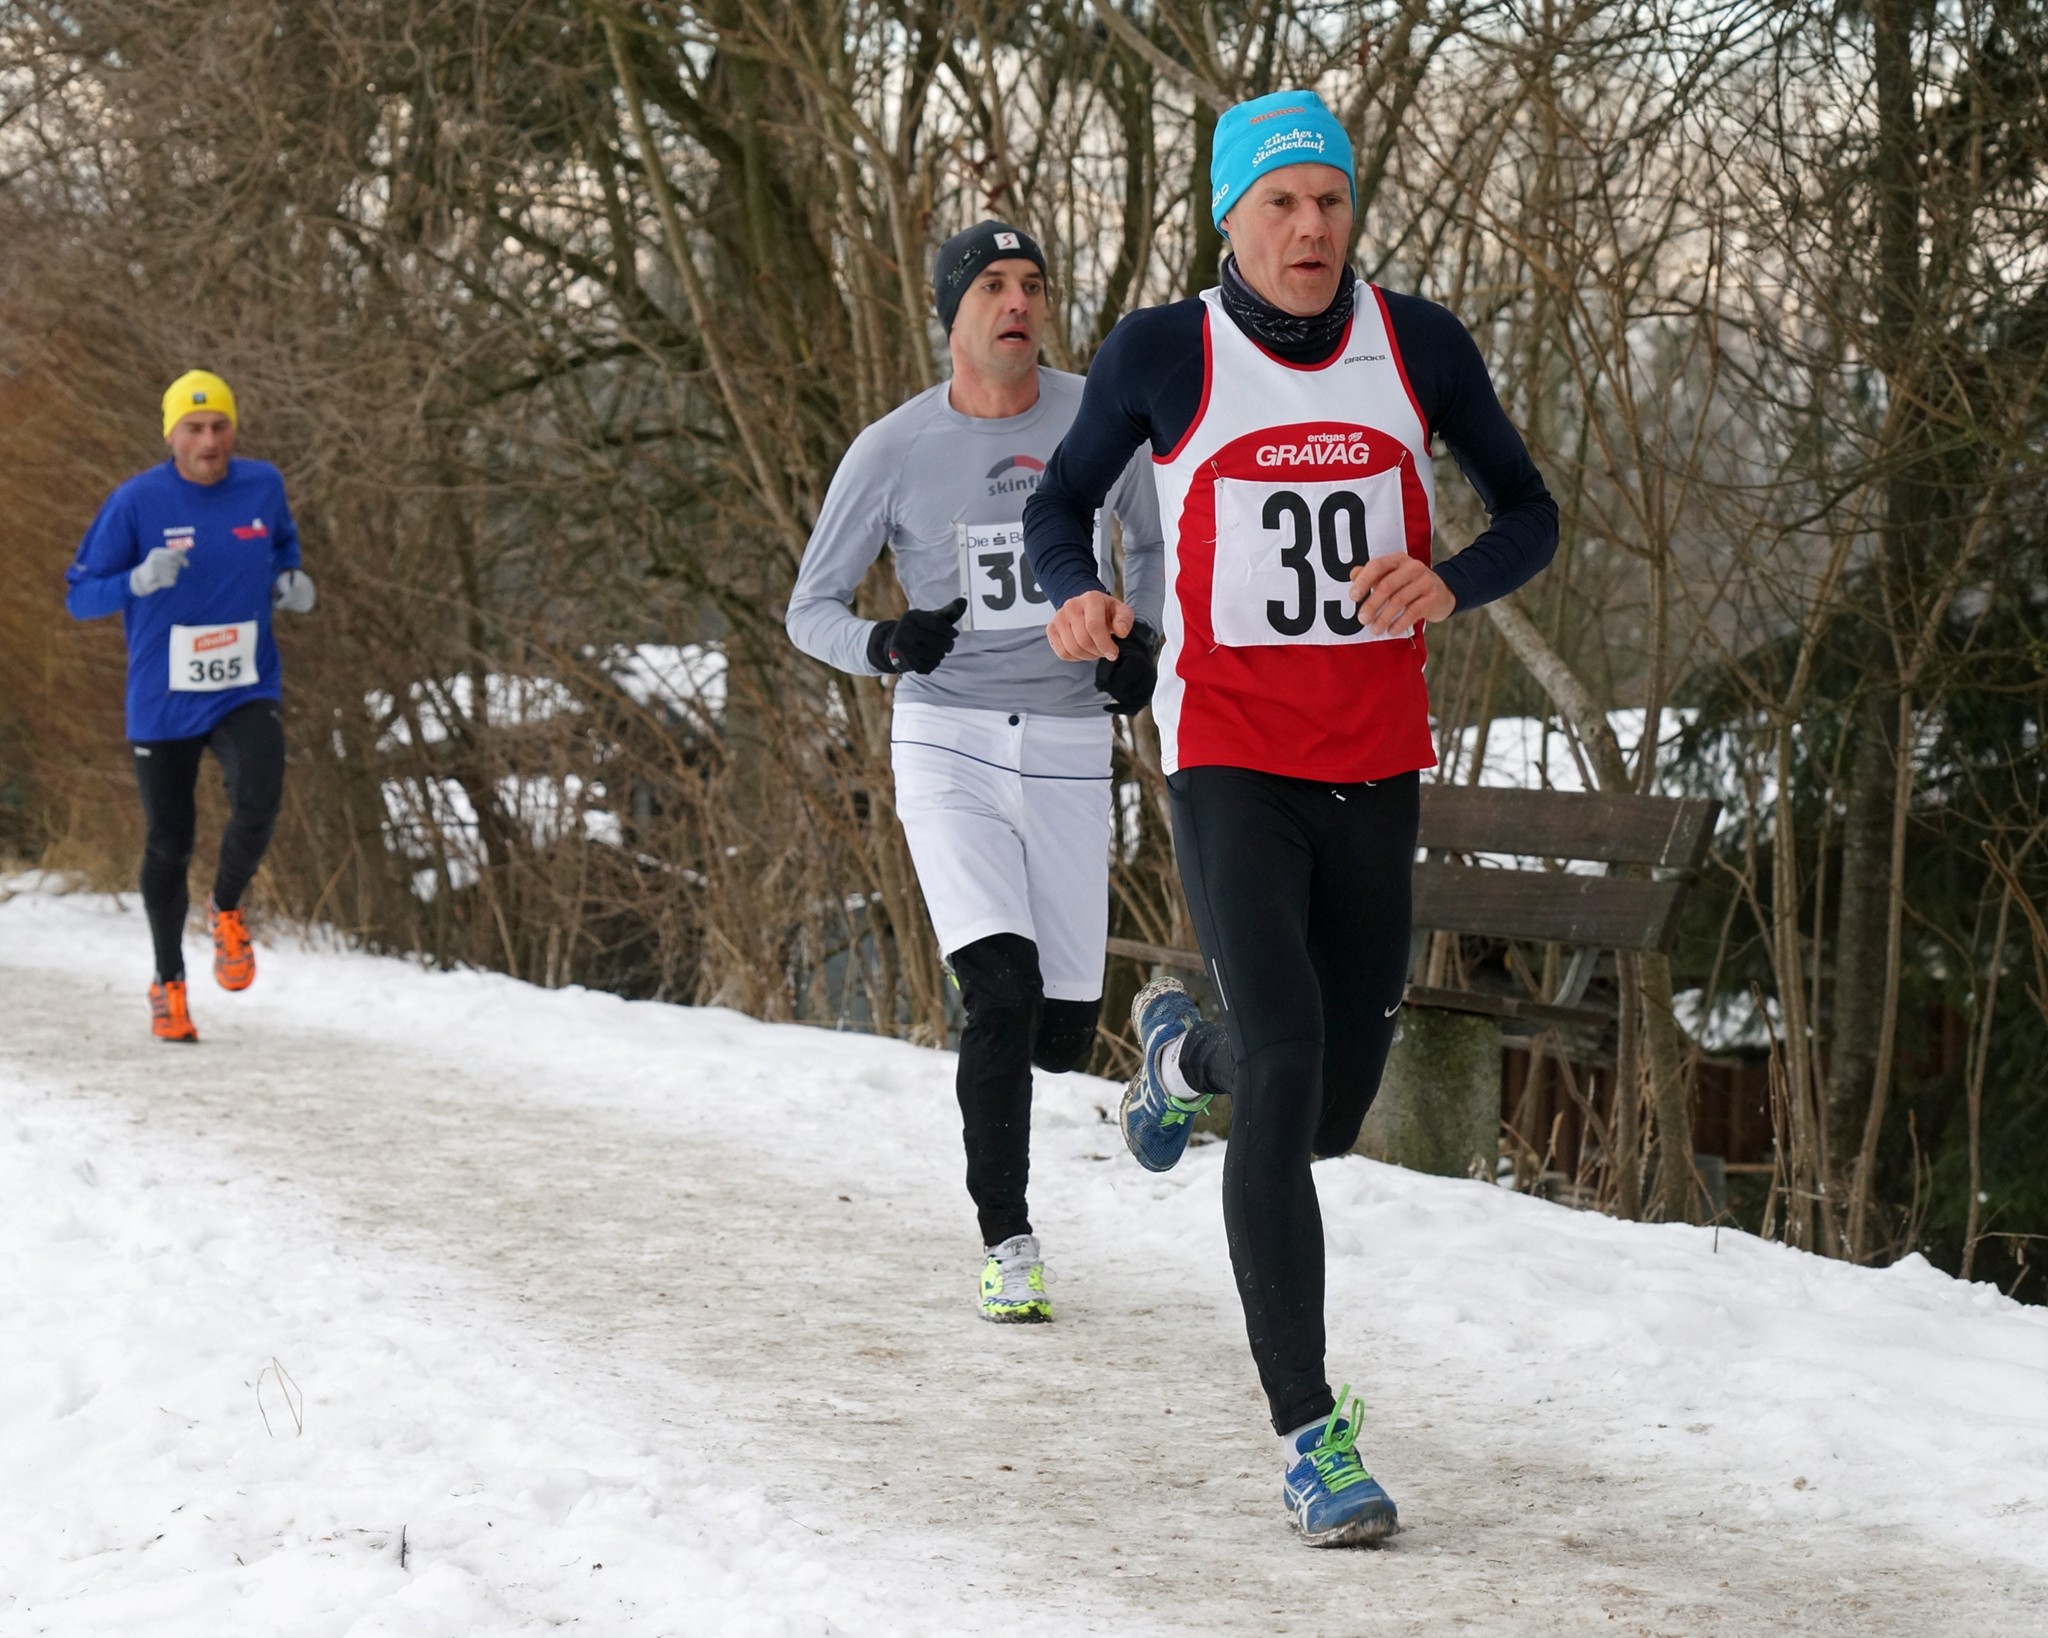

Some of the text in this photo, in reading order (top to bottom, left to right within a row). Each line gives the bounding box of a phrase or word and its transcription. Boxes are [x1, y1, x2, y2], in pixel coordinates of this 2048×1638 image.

[1264, 128, 1313, 149] Zürcher
[1252, 138, 1325, 168] Silvesterlauf
[1344, 354, 1386, 365] BROOKS
[1307, 433, 1346, 444] erdgas
[1256, 443, 1370, 467] GRAVAG
[967, 535, 989, 549] Die
[1262, 490, 1372, 637] 39
[189, 656, 243, 683] 365
